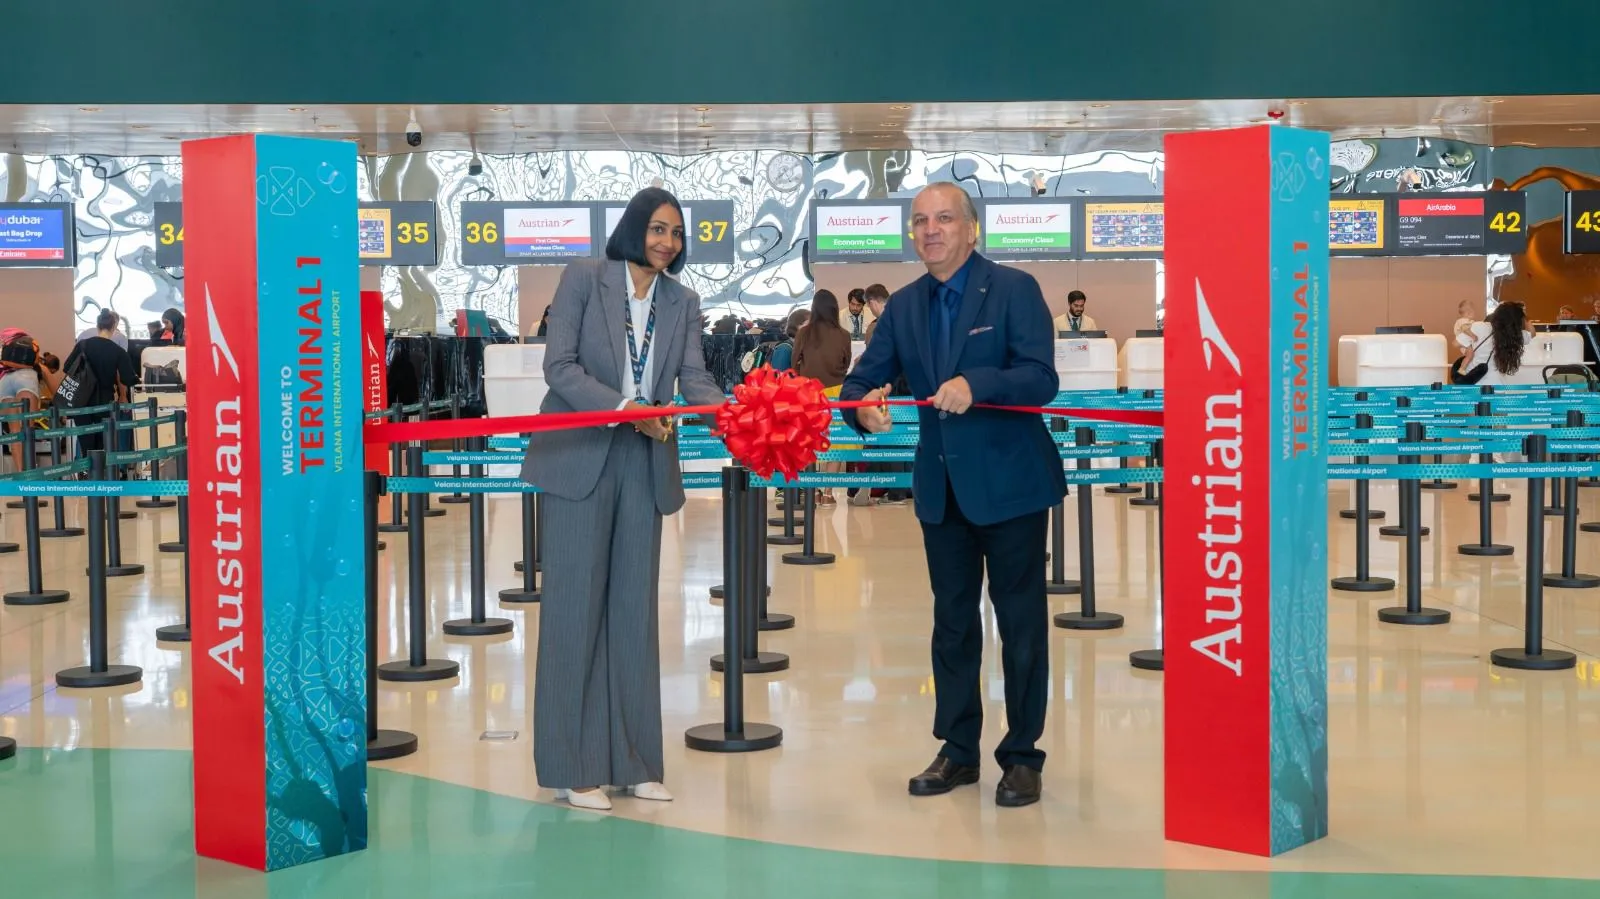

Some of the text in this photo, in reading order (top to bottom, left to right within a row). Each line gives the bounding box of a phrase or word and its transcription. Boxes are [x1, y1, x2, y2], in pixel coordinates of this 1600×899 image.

[518, 218, 560, 228] Austrian
[826, 216, 874, 226] Austrian
[996, 214, 1042, 224] Austrian
[1490, 212, 1521, 233] 42
[397, 222, 429, 244] 35
[466, 222, 498, 243] 36
[698, 221, 728, 242] 37
[1293, 242, 1309, 458] TERMINAL 1
[296, 256, 324, 474] TERMINAL 1
[57, 385, 74, 400] BAG
[332, 290, 342, 473] VELANA INTERNATIONAL AIRPORT
[368, 363, 381, 425] ustrian
[1282, 350, 1291, 460] WELCOME TO
[281, 366, 294, 476] WELCOME TO
[97, 485, 123, 493] Airport
[207, 396, 244, 685] Austrian
[1190, 389, 1243, 677] Austrian
